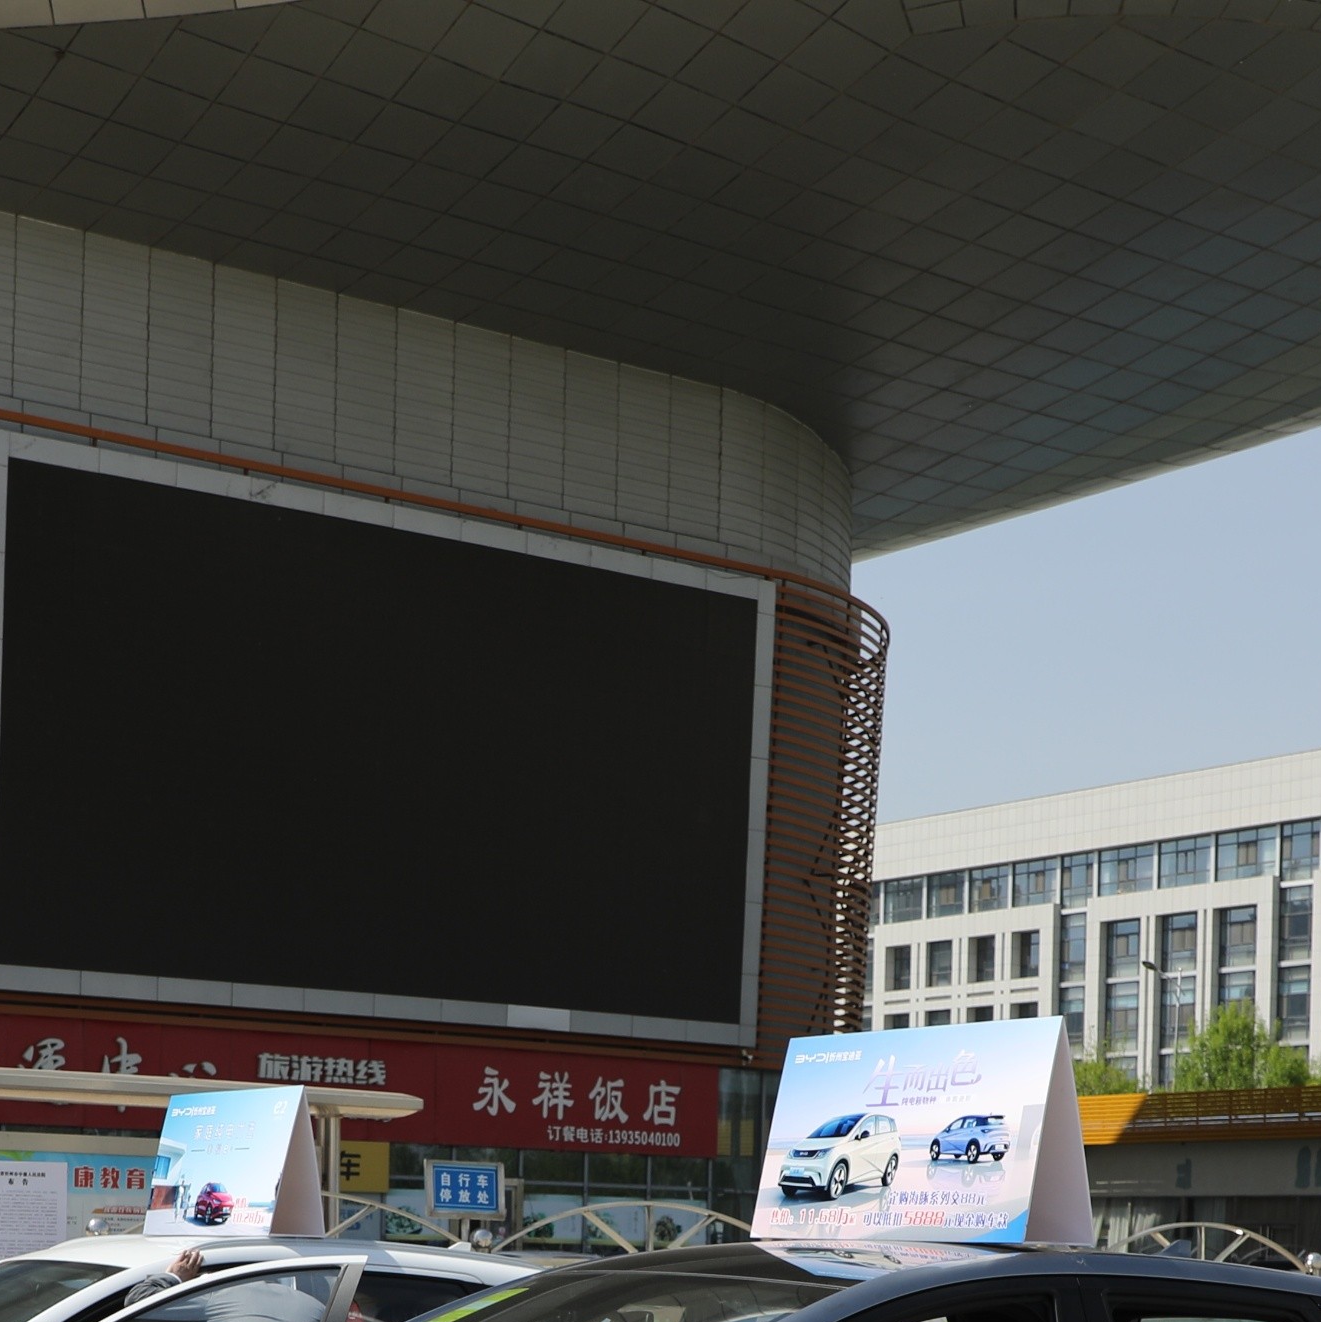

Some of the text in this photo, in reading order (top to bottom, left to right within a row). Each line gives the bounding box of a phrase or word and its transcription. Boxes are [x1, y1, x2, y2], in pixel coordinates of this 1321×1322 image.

[258, 1052, 387, 1086] 旅游热线
[862, 1049, 983, 1107] 生而出色
[472, 1065, 682, 1127] 永祥饭店
[74, 1166, 145, 1191] 康教育
[340, 1150, 361, 1181] 车
[440, 1171, 489, 1189] 自行车
[440, 1188, 490, 1205] 停放处
